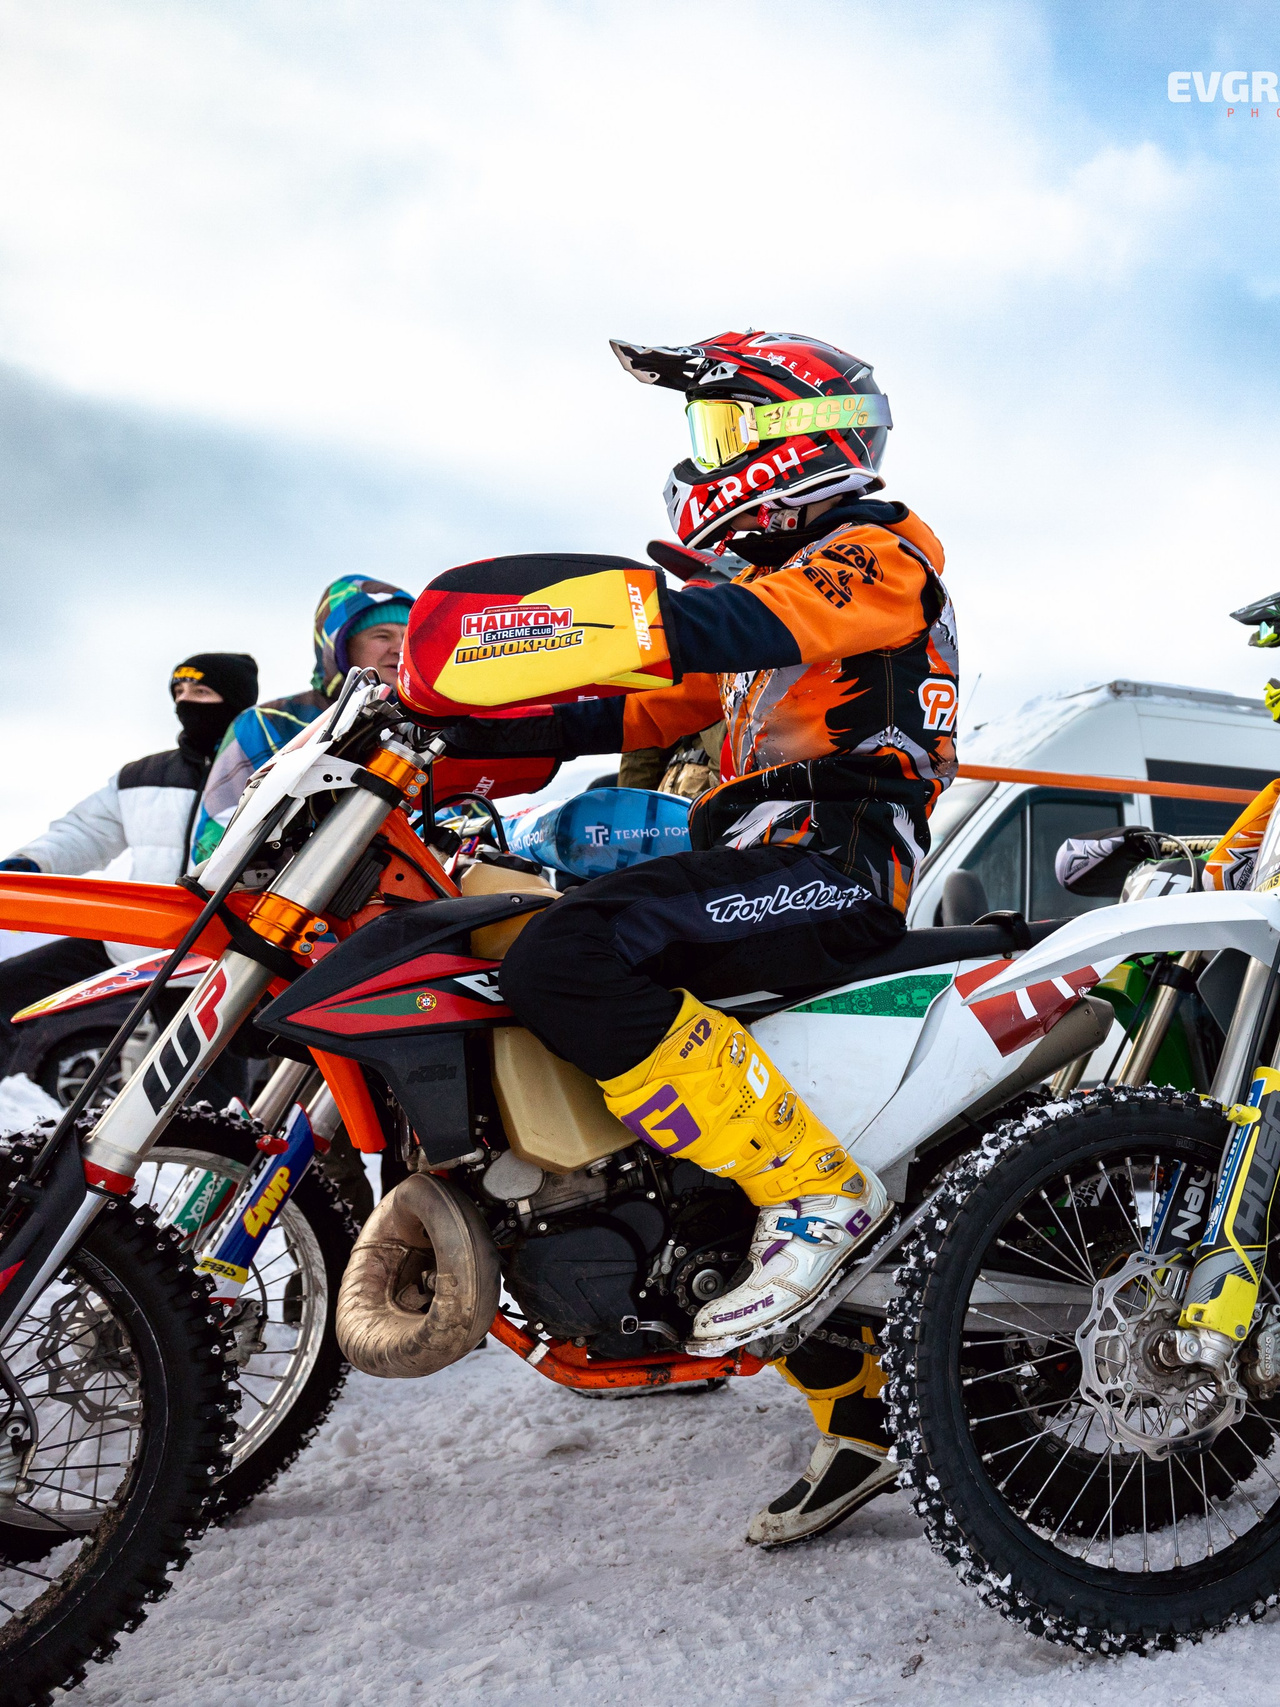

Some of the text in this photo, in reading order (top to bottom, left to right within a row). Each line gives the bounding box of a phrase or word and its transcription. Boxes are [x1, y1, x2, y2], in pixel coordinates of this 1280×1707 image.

[762, 398, 869, 437] 100%
[688, 447, 803, 531] AIROH
[532, 627, 552, 635] CLUB
[614, 827, 660, 840] ТЕХНО
[706, 894, 773, 923] Troy
[407, 1064, 457, 1084] KTM
[712, 1293, 775, 1324] GAERNE
